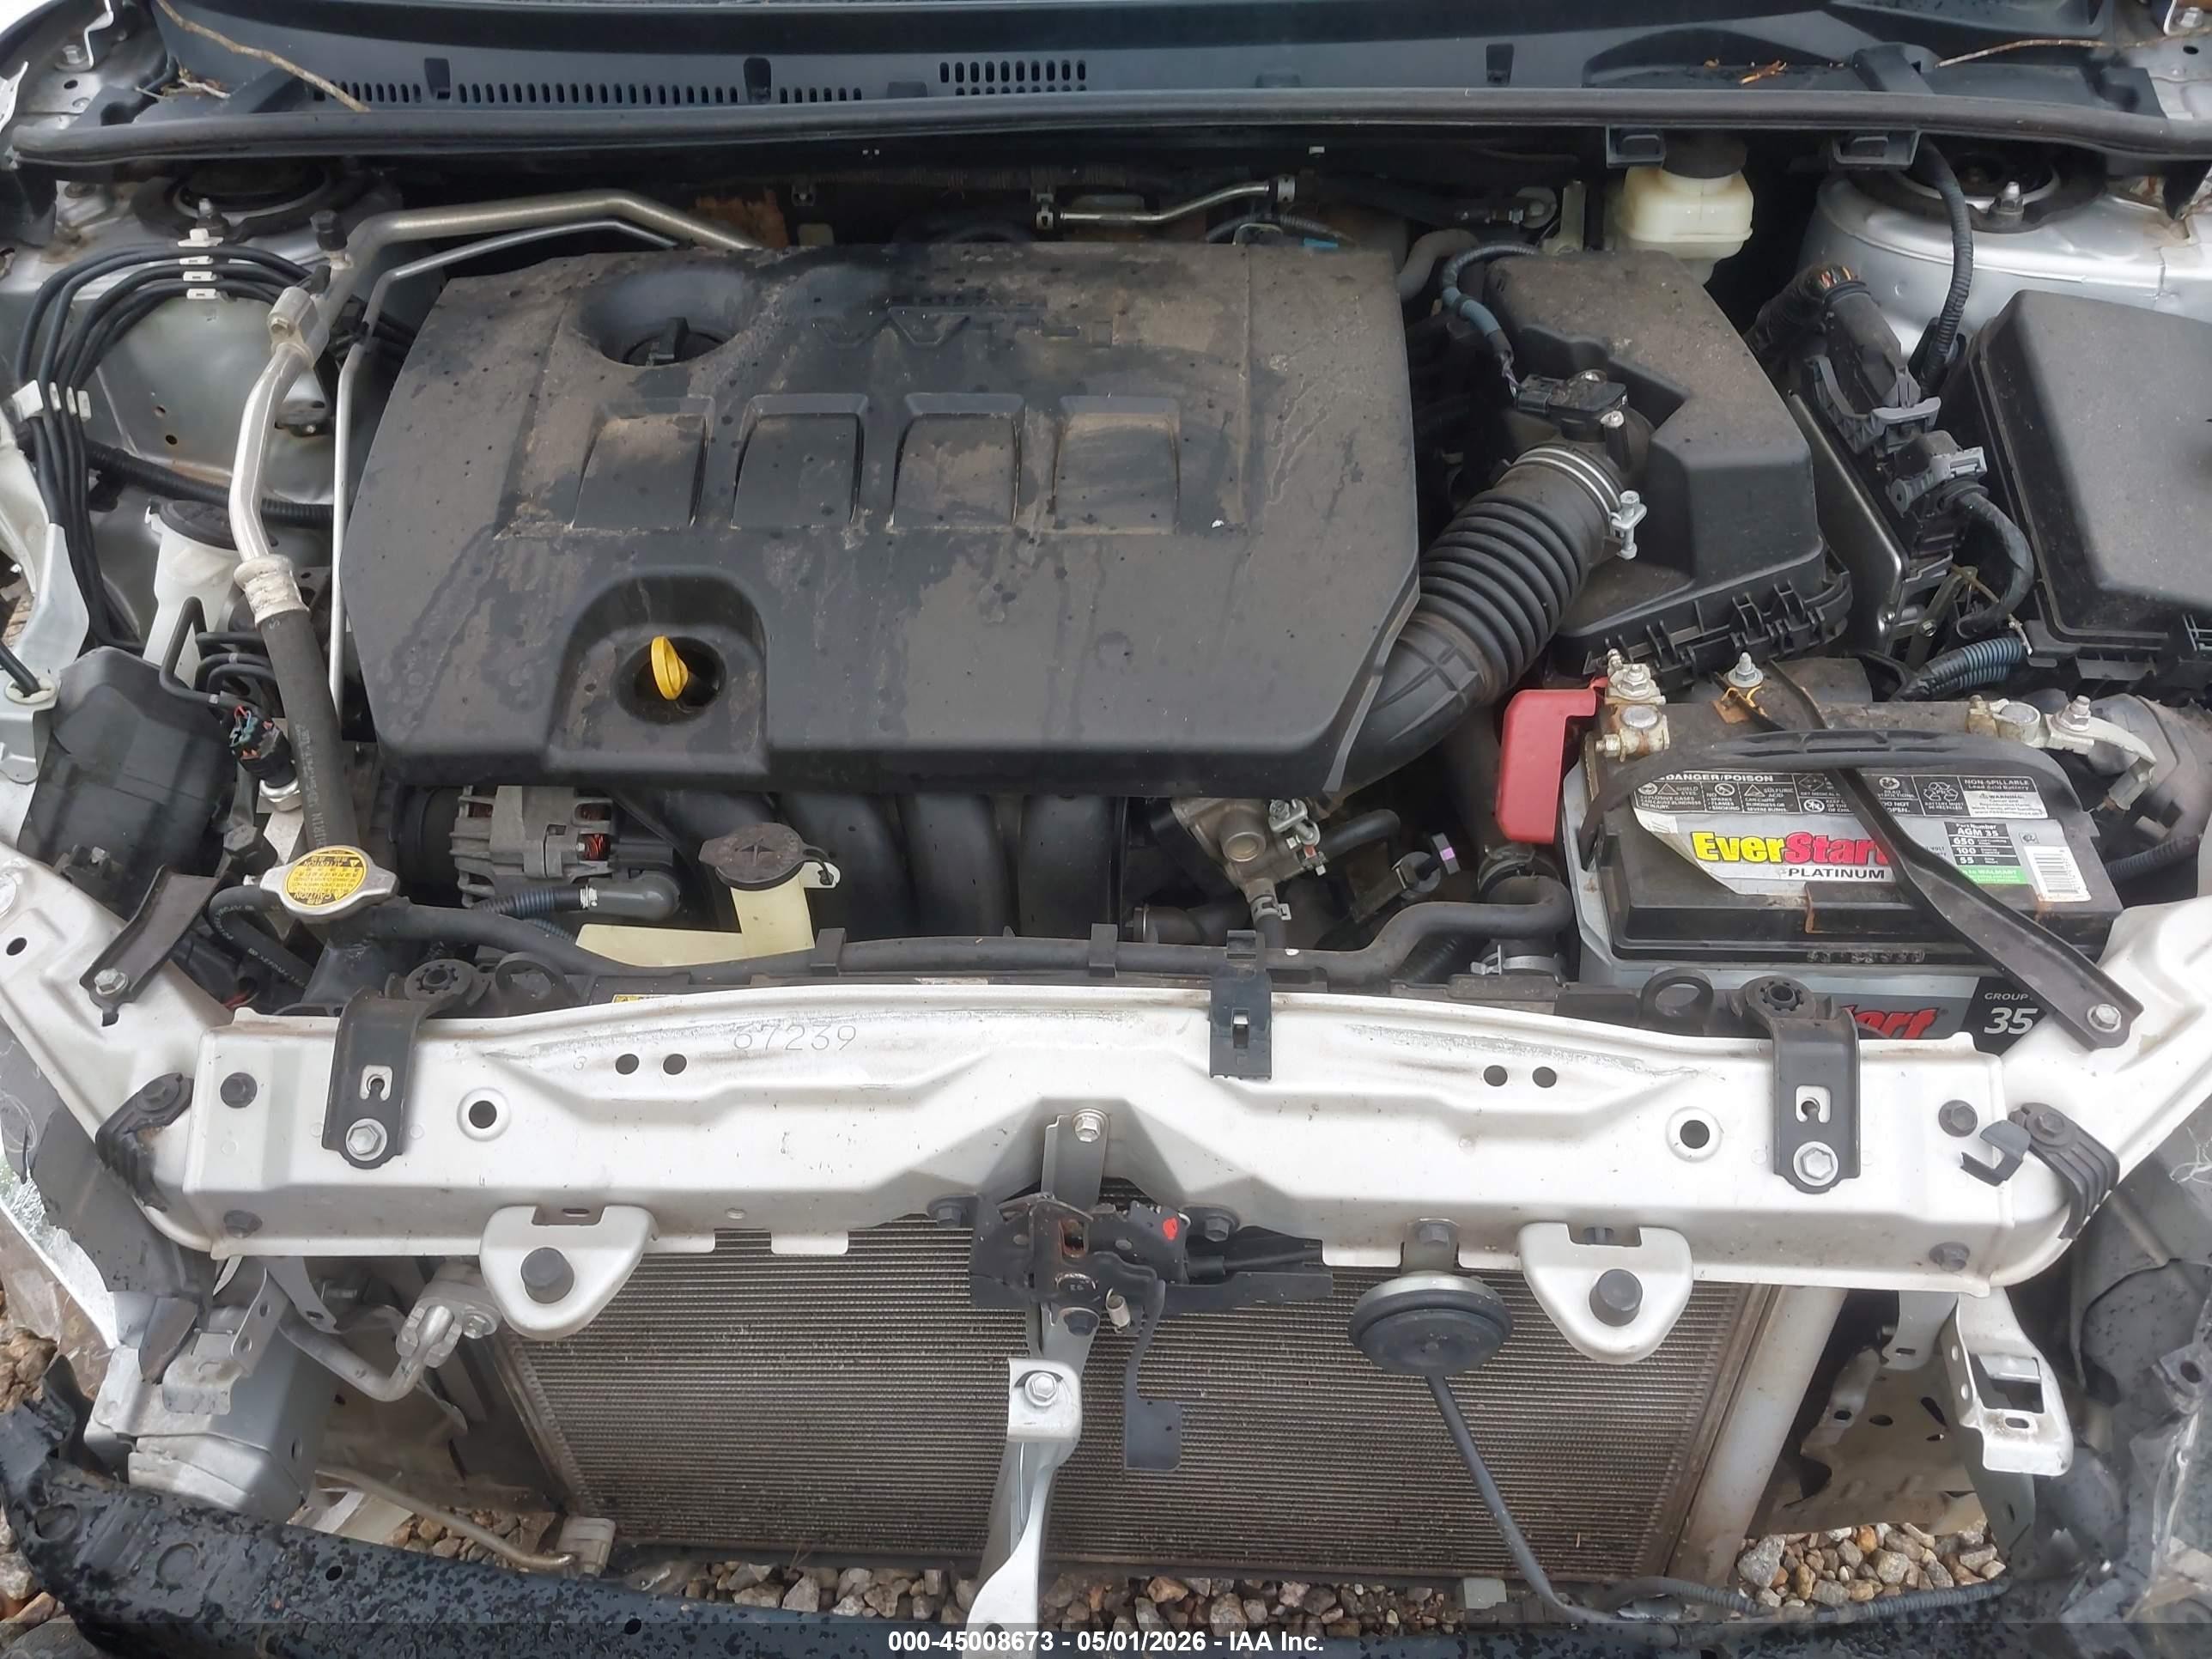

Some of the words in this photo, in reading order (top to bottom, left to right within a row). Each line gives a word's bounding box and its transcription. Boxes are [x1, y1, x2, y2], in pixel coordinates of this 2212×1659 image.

[1666, 774, 1773, 782] DANGER/POISON
[312, 811, 327, 848] HIRIN
[1958, 828, 1984, 836] AGM
[1789, 868, 1885, 879] PLATINUM
[1984, 992, 2029, 1001] GROUP
[1984, 1007, 2039, 1035] 35
